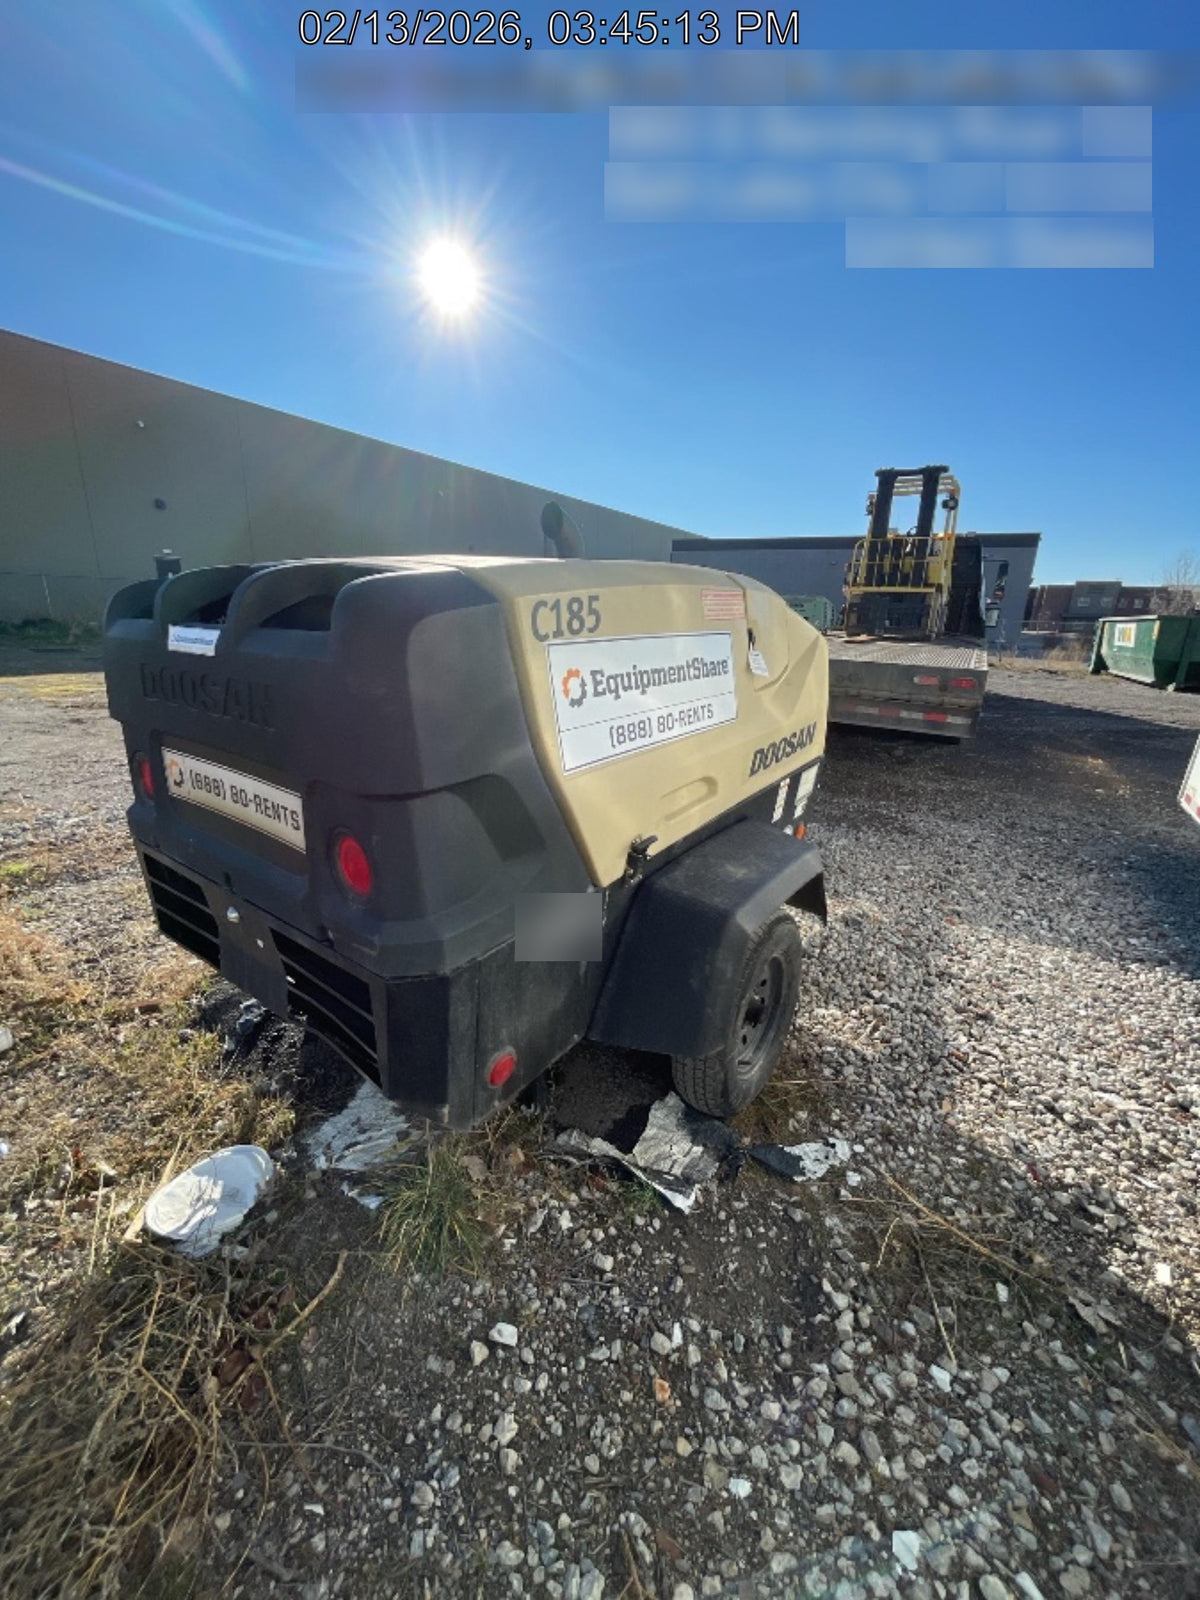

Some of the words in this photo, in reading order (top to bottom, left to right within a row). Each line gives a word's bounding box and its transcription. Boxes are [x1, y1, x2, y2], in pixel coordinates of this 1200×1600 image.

[531, 595, 602, 642] C185
[590, 656, 730, 700] EquipmentShare
[609, 716, 653, 749] (888)
[657, 703, 715, 733] 80-RENTS
[749, 721, 816, 777] DOOSAN
[230, 784, 301, 831] 80-RENTS
